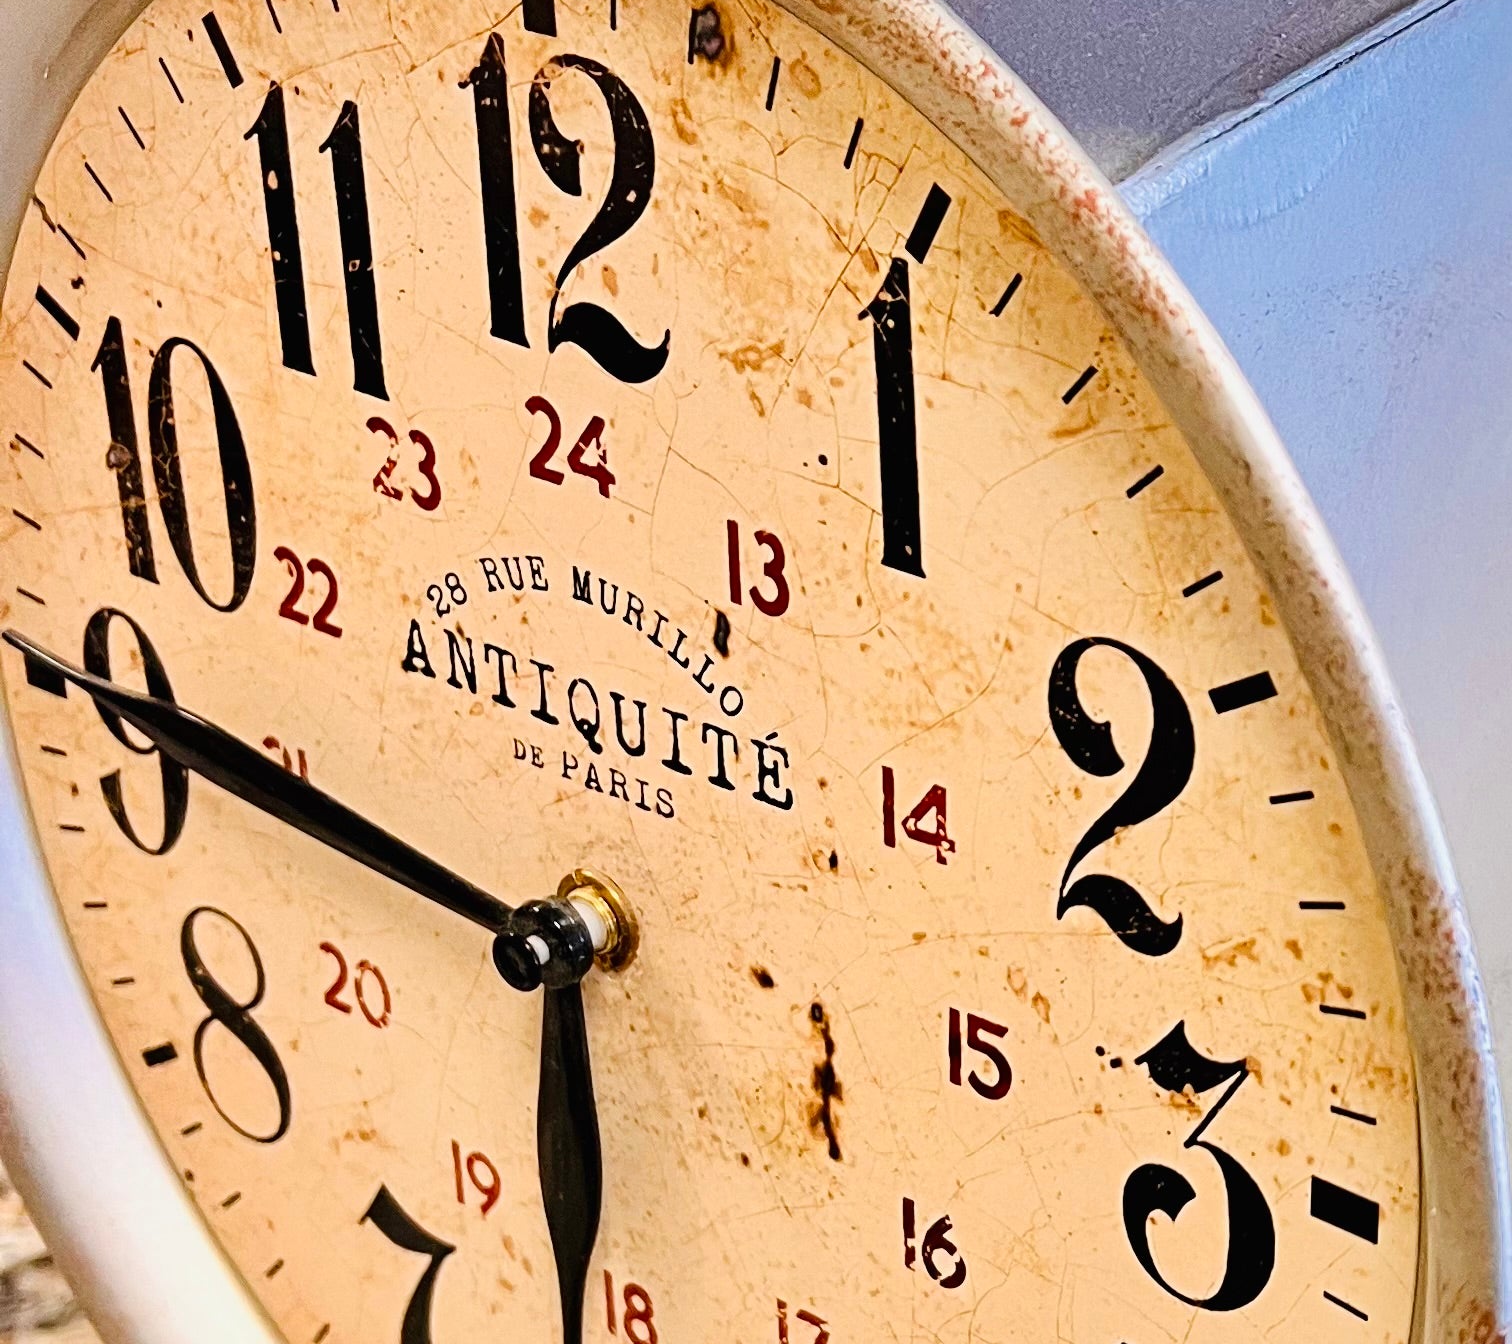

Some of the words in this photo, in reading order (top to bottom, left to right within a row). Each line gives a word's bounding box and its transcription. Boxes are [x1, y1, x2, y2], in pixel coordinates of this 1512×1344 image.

[244, 80, 390, 402] 11
[459, 32, 671, 384] 12
[91, 317, 257, 612] 10
[366, 416, 442, 511] 23
[524, 395, 617, 498] 24
[858, 257, 926, 578] 1
[274, 546, 344, 638] 22
[726, 519, 790, 617] 13
[426, 572, 468, 617] 28
[479, 555, 549, 592] RUE
[572, 566, 744, 716] MURILLO
[83, 607, 190, 855] 9
[401, 619, 794, 811] ANTIQUITÉ
[513, 738, 545, 768] DE
[562, 750, 676, 819] PARIS
[881, 765, 956, 864] 14
[1048, 637, 1196, 957] 2
[181, 906, 292, 1143] 8
[319, 942, 393, 1028] 20
[948, 1008, 1014, 1100] 15
[451, 1139, 502, 1216] 19
[1123, 1020, 1277, 1312] 3
[902, 1196, 968, 1289] 16
